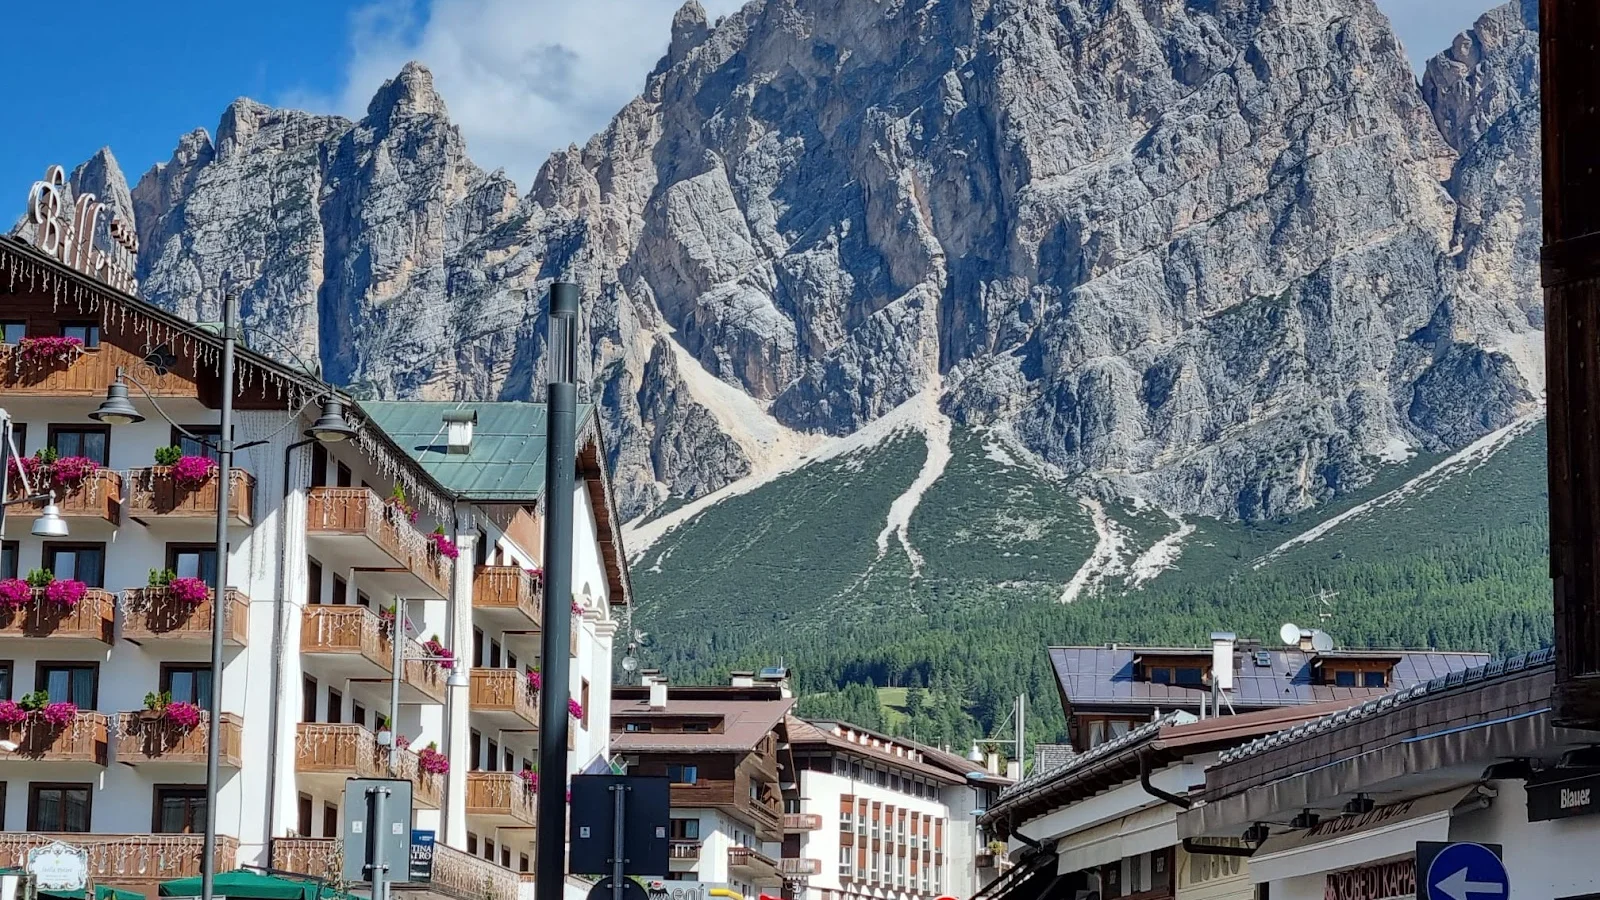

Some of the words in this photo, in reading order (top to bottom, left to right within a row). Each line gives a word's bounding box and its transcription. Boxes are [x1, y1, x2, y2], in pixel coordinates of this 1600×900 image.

[1560, 788, 1590, 808] Blauer
[1340, 867, 1367, 900] ROBE
[1368, 866, 1380, 899] DI
[1383, 861, 1417, 897] KAPPA
